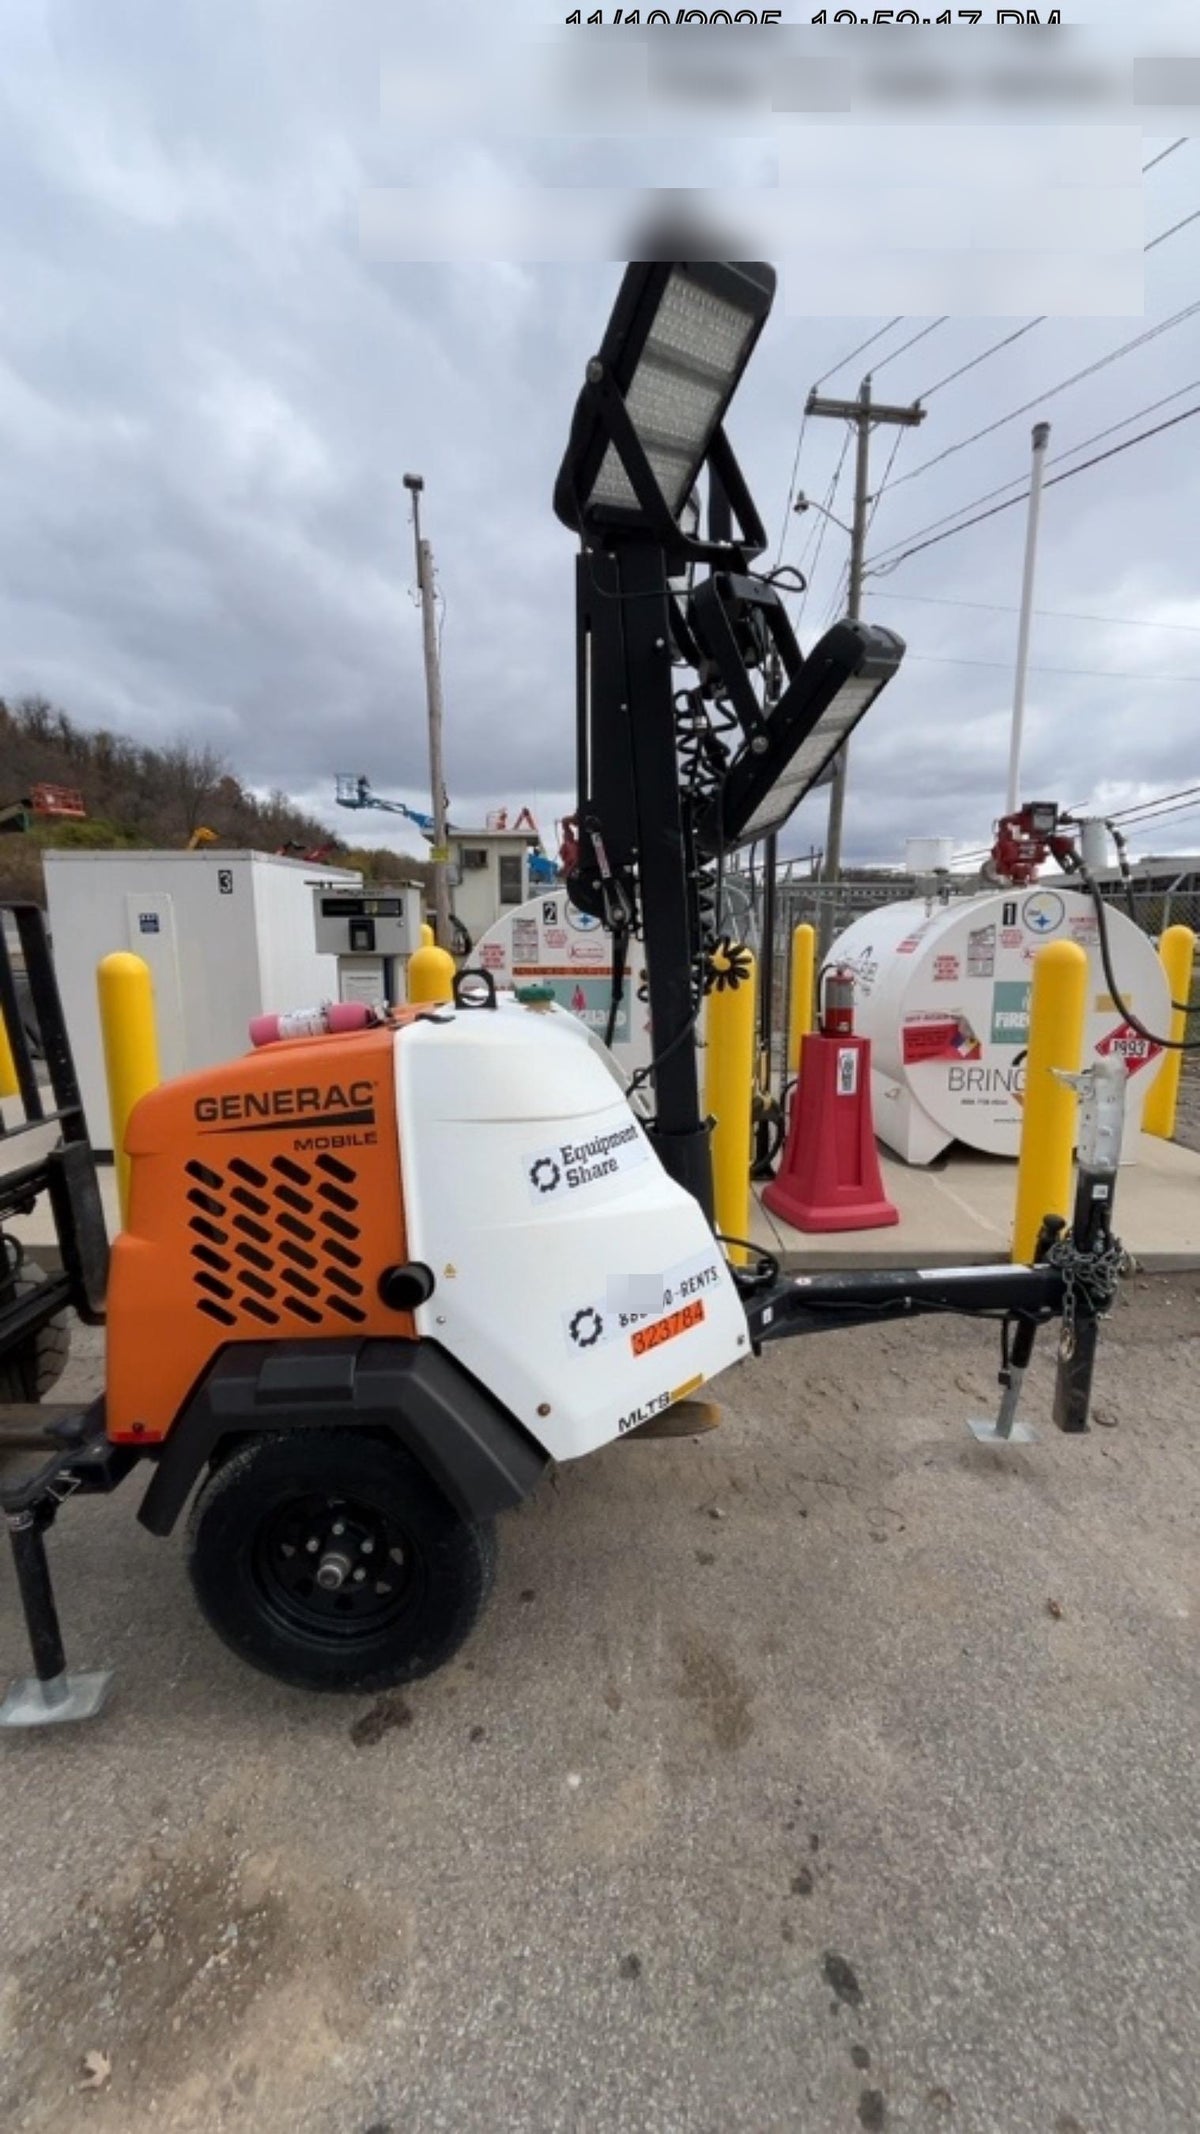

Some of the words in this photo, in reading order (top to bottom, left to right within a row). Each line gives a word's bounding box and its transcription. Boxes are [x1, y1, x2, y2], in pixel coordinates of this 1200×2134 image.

[219, 870, 231, 892] 3
[194, 1081, 373, 1122] GENERAC
[293, 1131, 377, 1150] MOBILE
[560, 1124, 639, 1165] Equipment
[566, 1158, 619, 1188] Share
[632, 1298, 704, 1355] 323784
